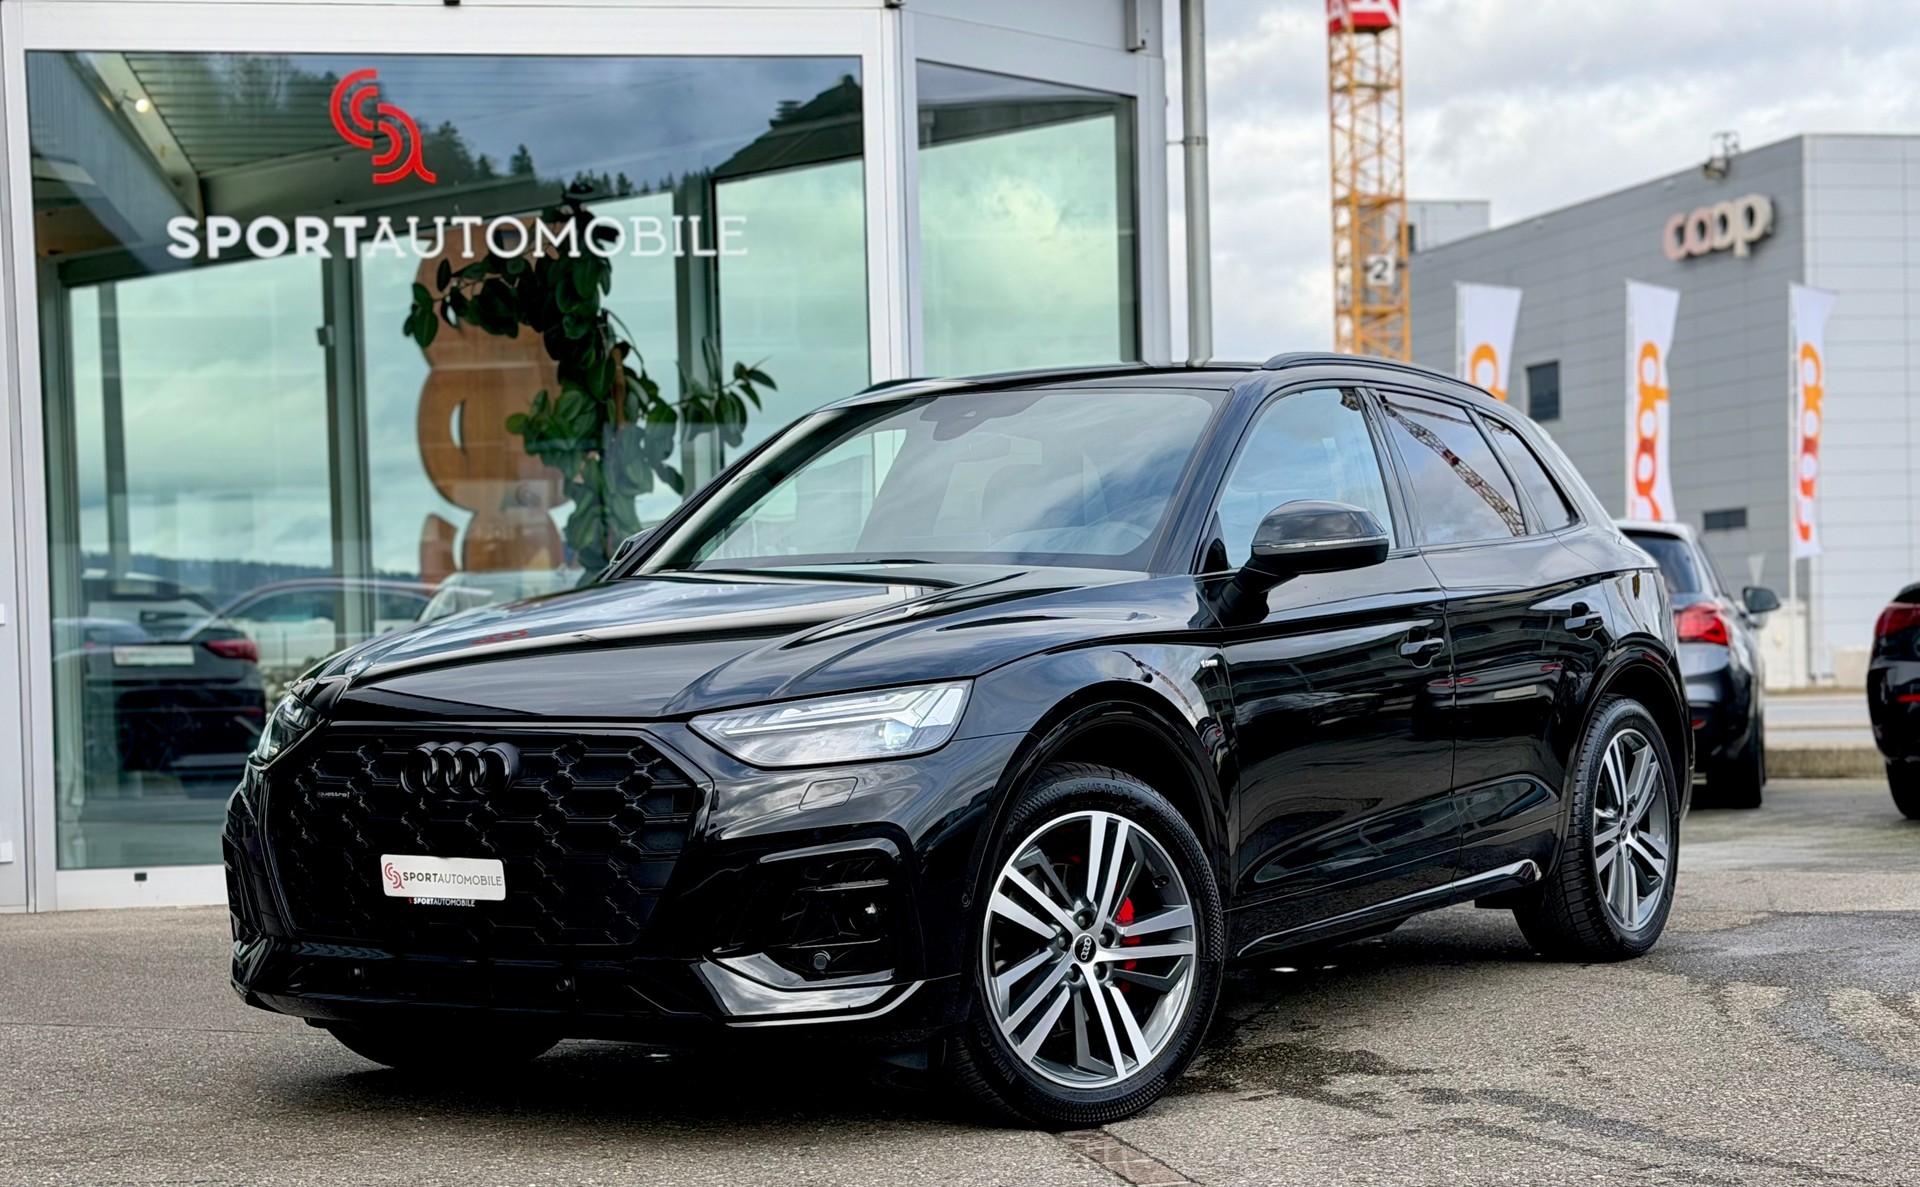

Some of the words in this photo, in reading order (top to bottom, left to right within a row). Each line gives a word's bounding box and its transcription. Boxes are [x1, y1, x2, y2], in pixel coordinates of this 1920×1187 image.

[166, 215, 748, 260] SPORTAUTOMOBILE
[1663, 193, 1773, 262] coop
[1369, 258, 1388, 280] 2
[403, 871, 503, 887] SPORTAUTOMOBILE
[413, 897, 476, 908] SPORTAUTOMOBILE
